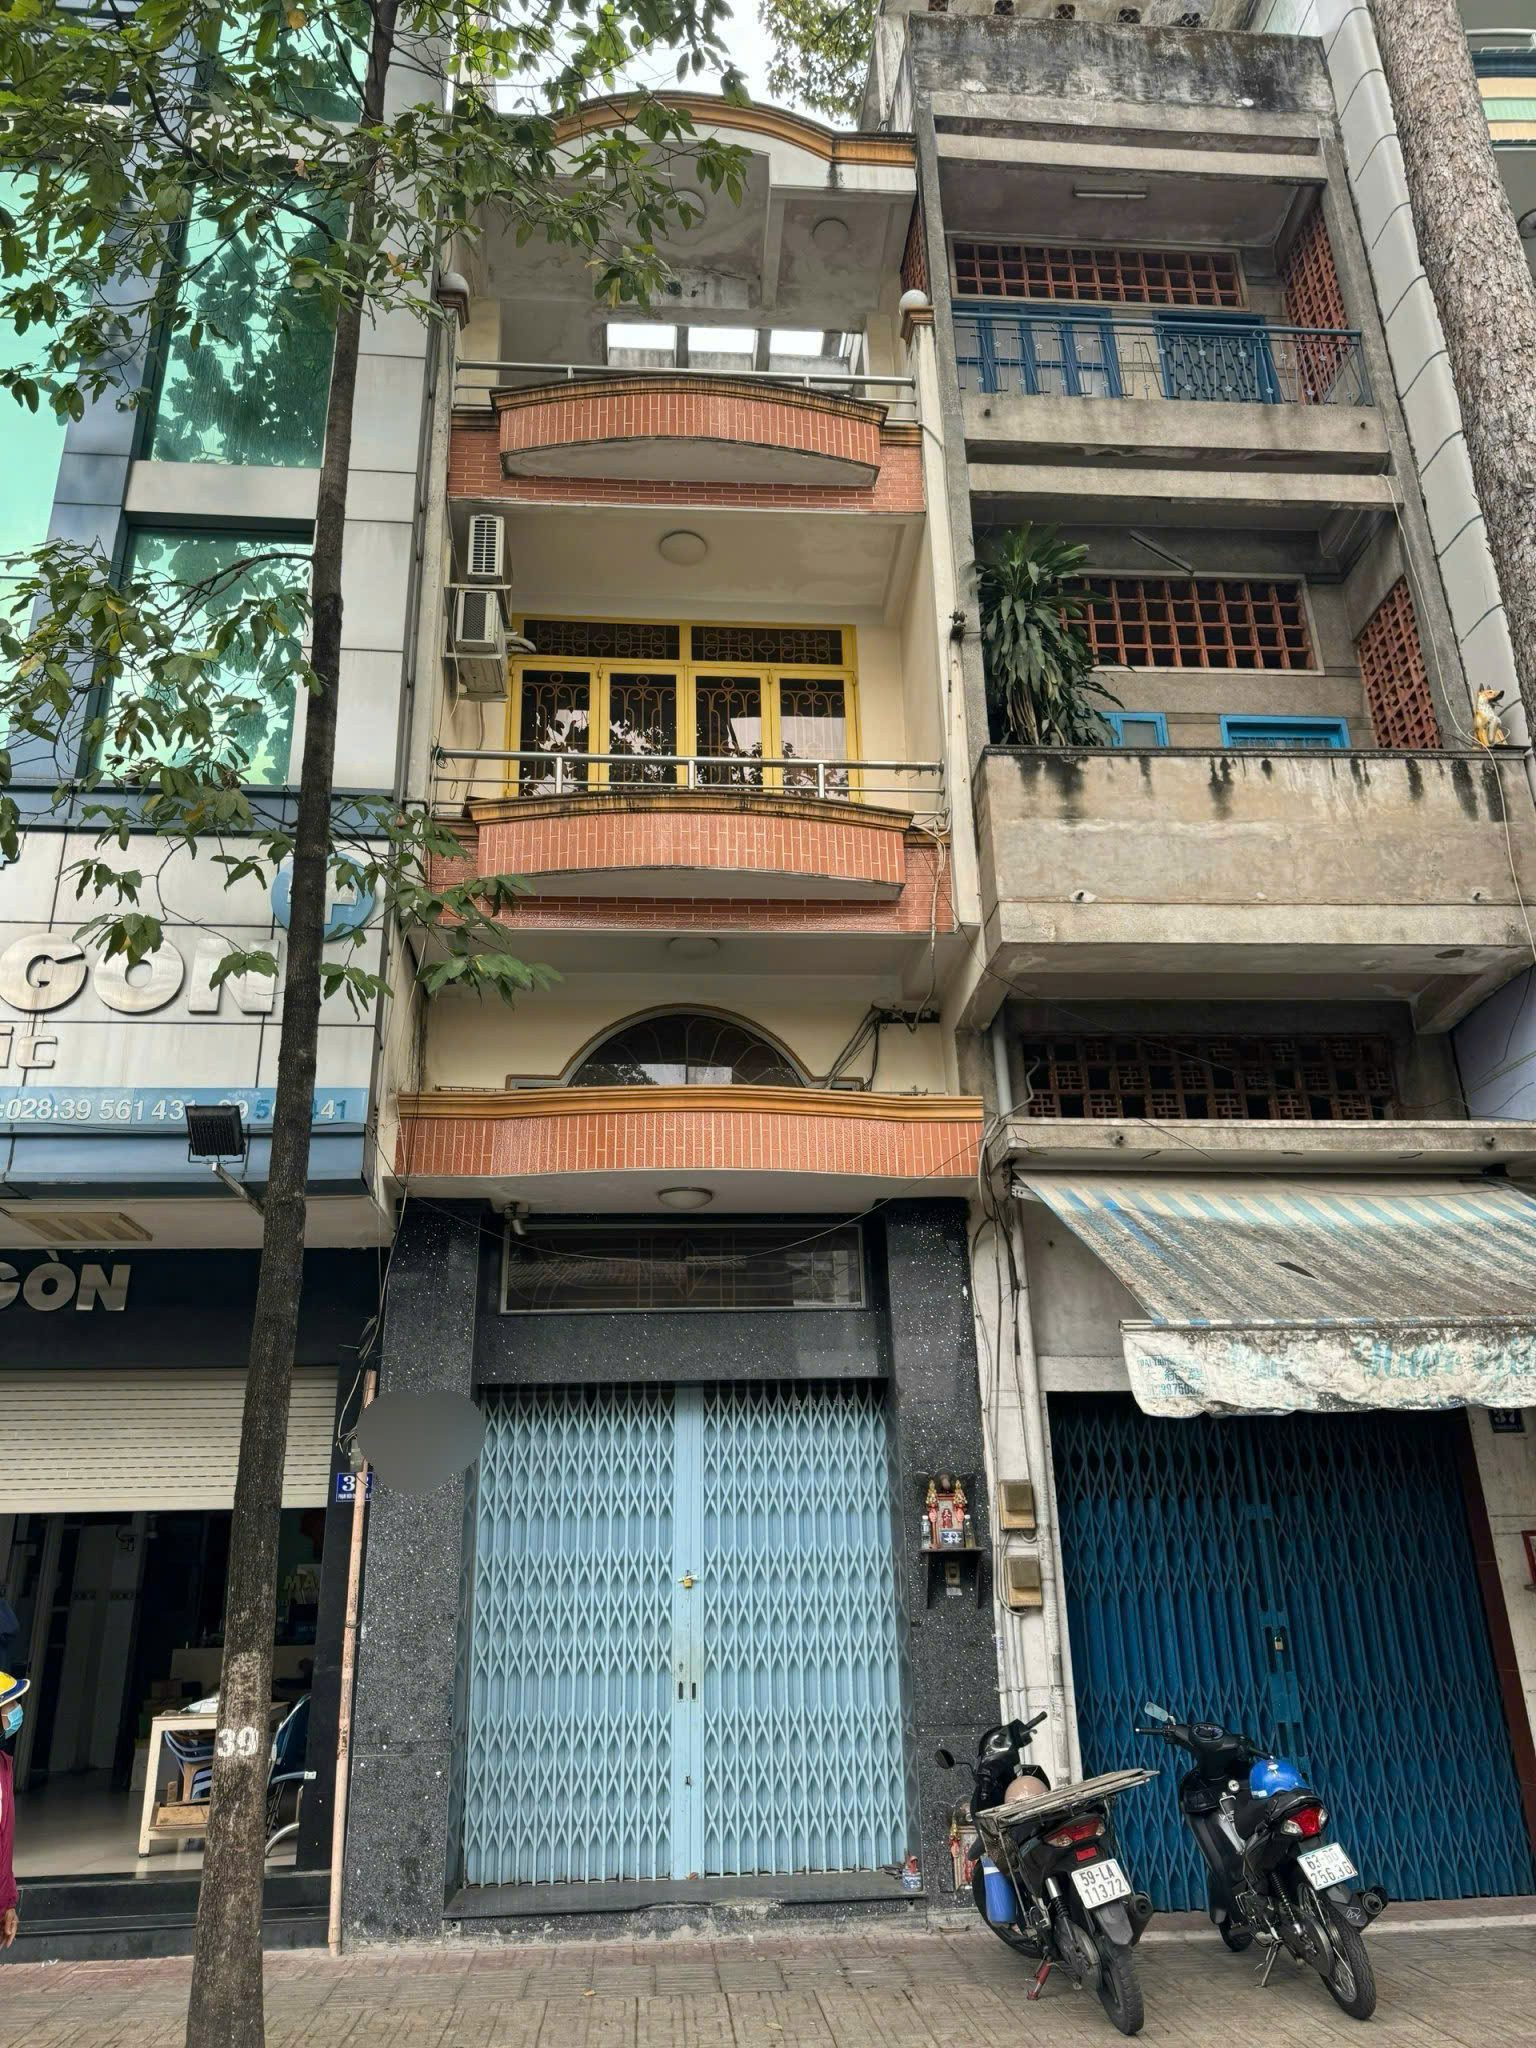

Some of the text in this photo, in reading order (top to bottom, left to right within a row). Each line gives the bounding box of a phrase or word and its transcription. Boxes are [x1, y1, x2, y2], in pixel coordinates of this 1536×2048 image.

[98, 1099, 144, 1120] 561
[151, 1099, 196, 1121] 43
[217, 1726, 259, 1757] 39
[1080, 1864, 1115, 1887] 59-LA
[1084, 1878, 1126, 1904] 113.72
